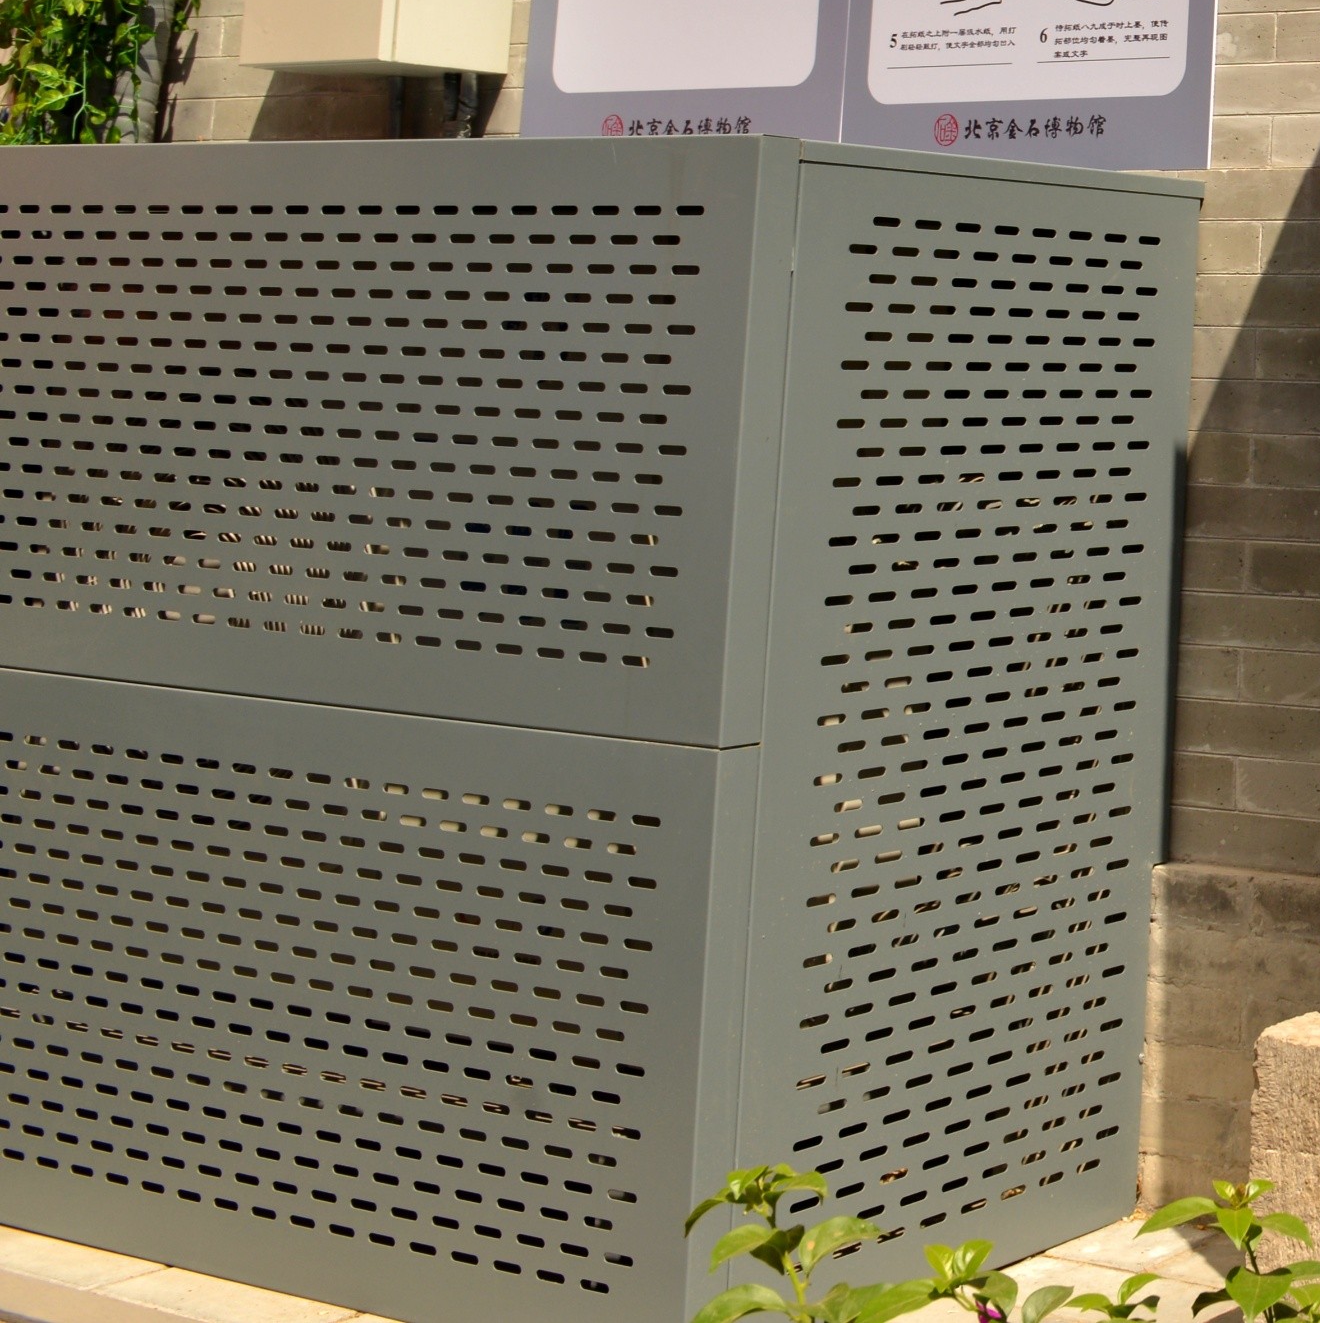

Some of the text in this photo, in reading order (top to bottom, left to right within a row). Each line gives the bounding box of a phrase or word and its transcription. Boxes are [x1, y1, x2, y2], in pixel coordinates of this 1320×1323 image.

[889, 33, 898, 48] 5
[1039, 27, 1048, 43] 6
[964, 114, 1107, 140] 北京金石博物馆
